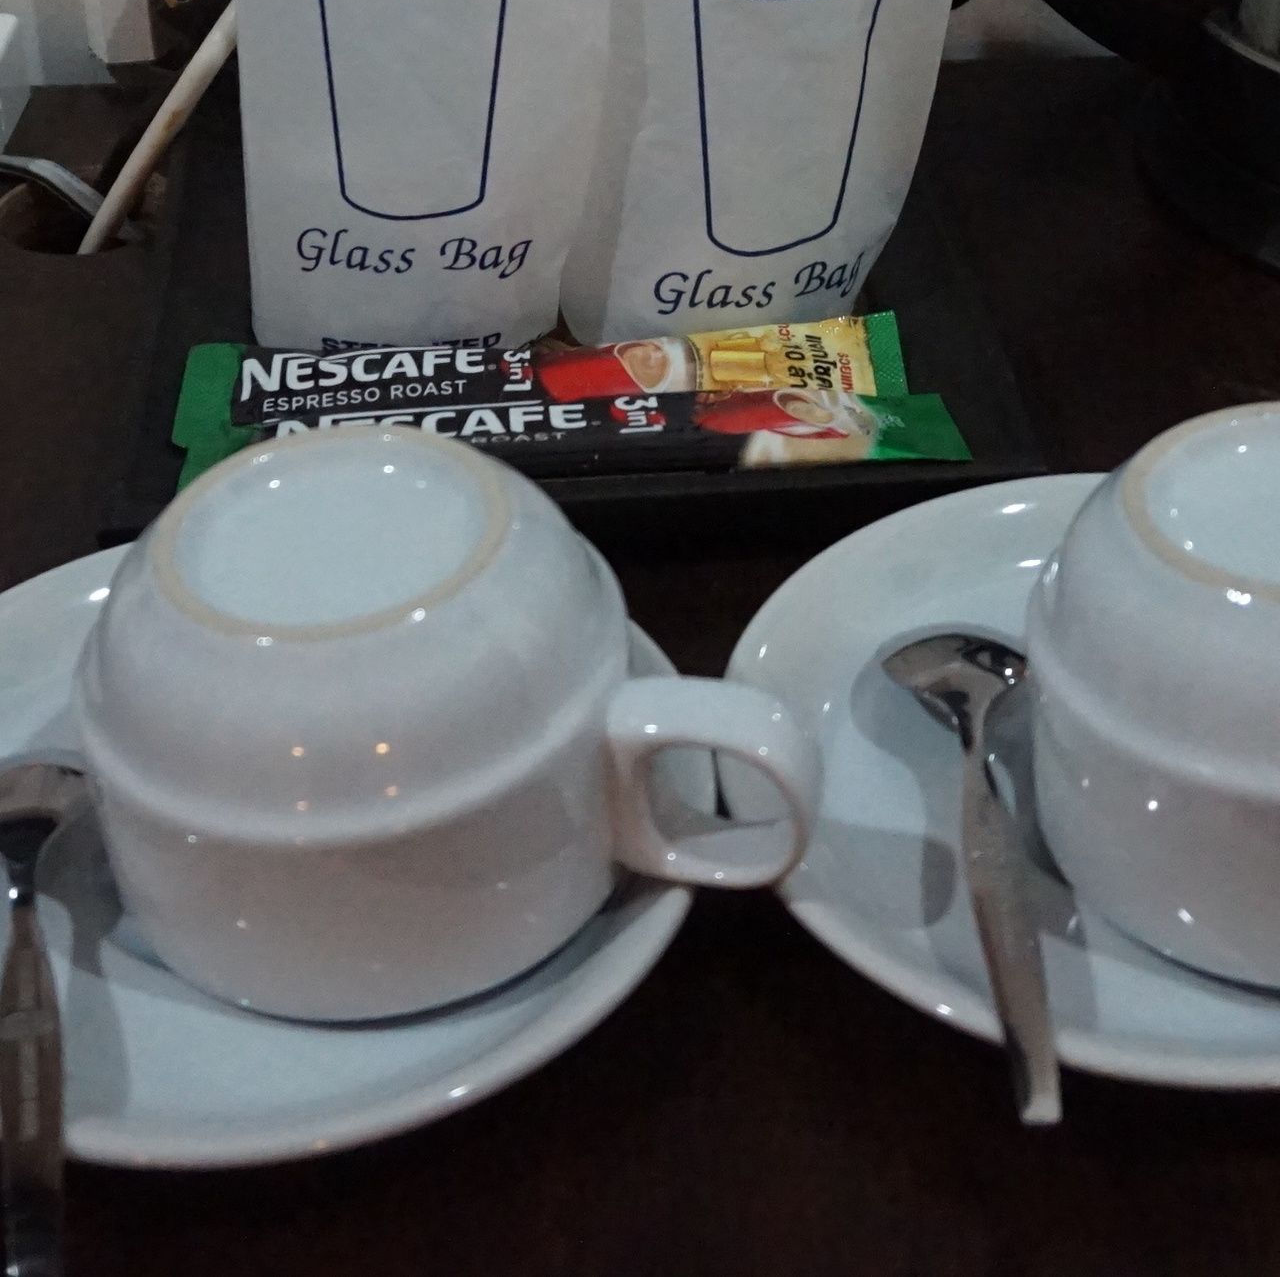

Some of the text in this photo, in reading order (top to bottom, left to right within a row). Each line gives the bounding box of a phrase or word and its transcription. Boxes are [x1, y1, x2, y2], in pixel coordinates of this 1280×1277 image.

[295, 226, 533, 279] Glass Bag
[653, 269, 776, 316] Glass
[262, 379, 468, 413] ESPRESSO ROAST
